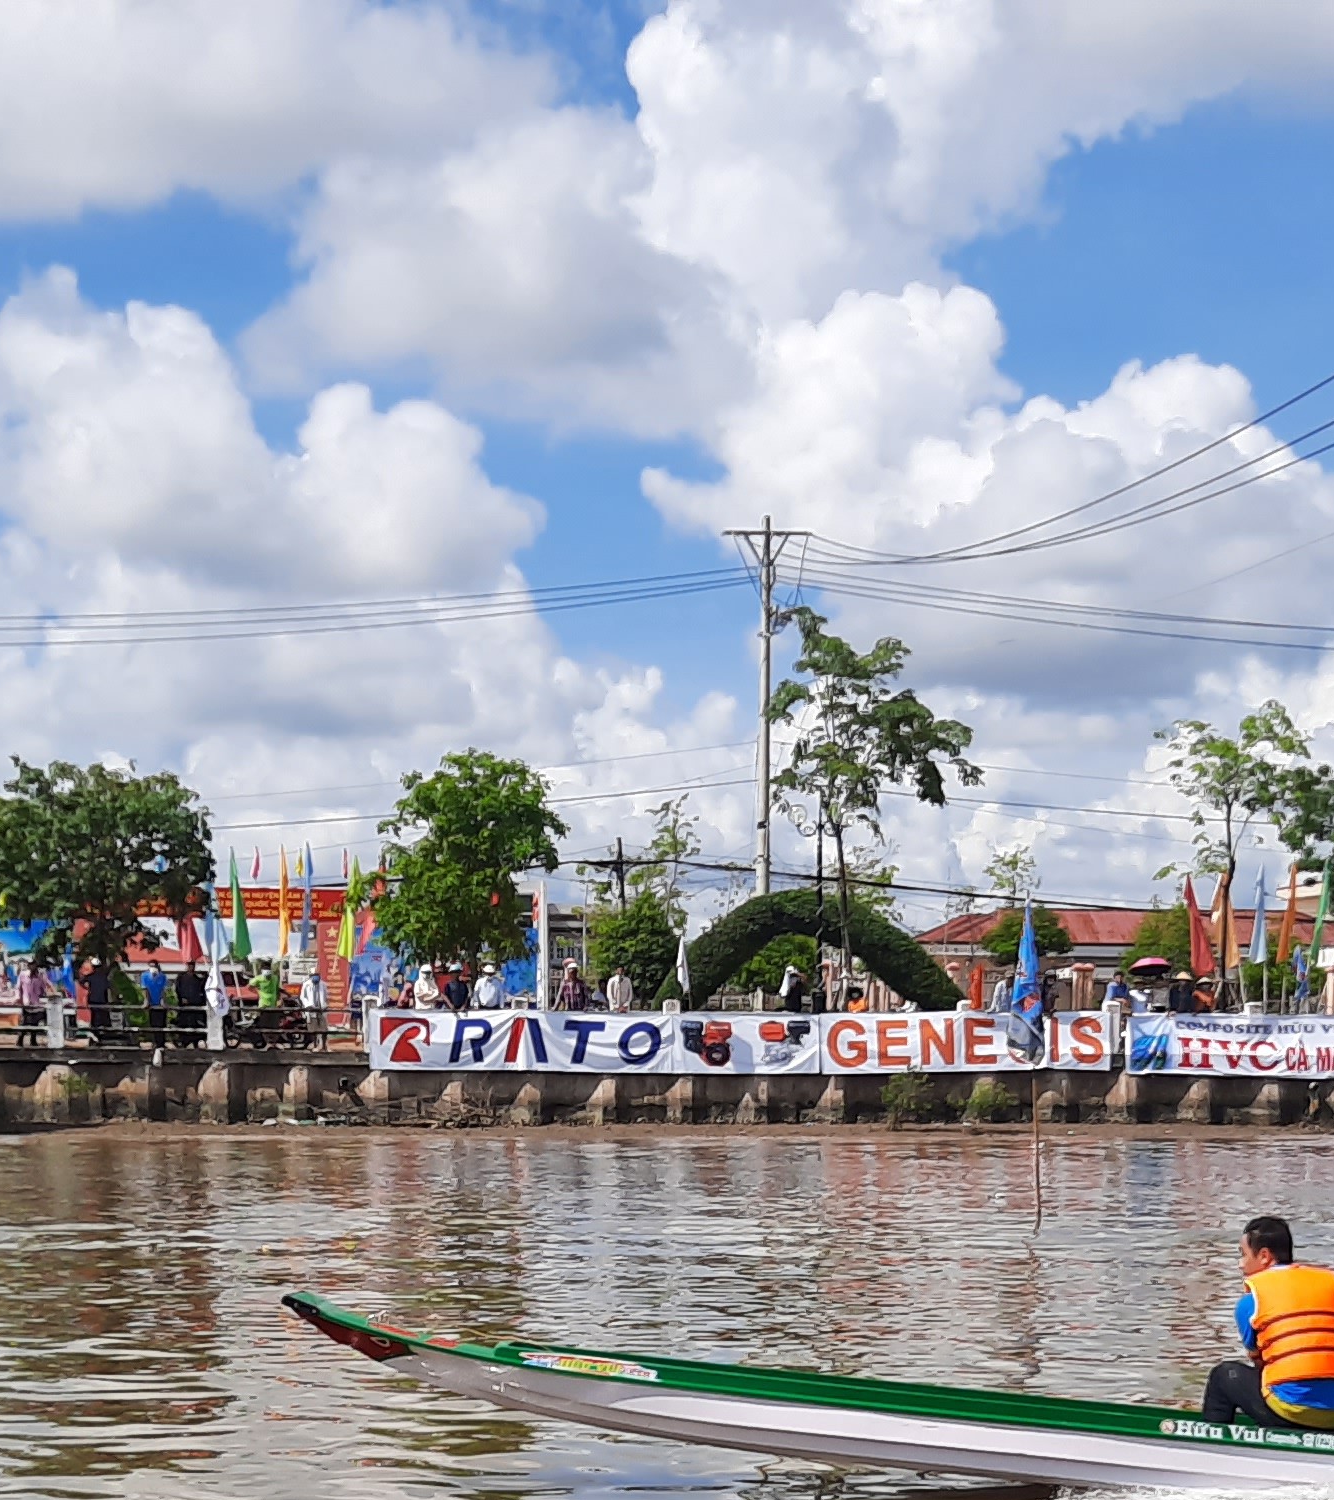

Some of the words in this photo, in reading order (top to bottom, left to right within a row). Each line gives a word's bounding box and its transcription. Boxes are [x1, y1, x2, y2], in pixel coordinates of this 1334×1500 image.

[448, 1017, 662, 1065] RATO
[827, 1017, 1104, 1068] GENEIS
[1175, 1020, 1273, 1036] COMPOSITE
[1177, 1037, 1281, 1071] HVC
